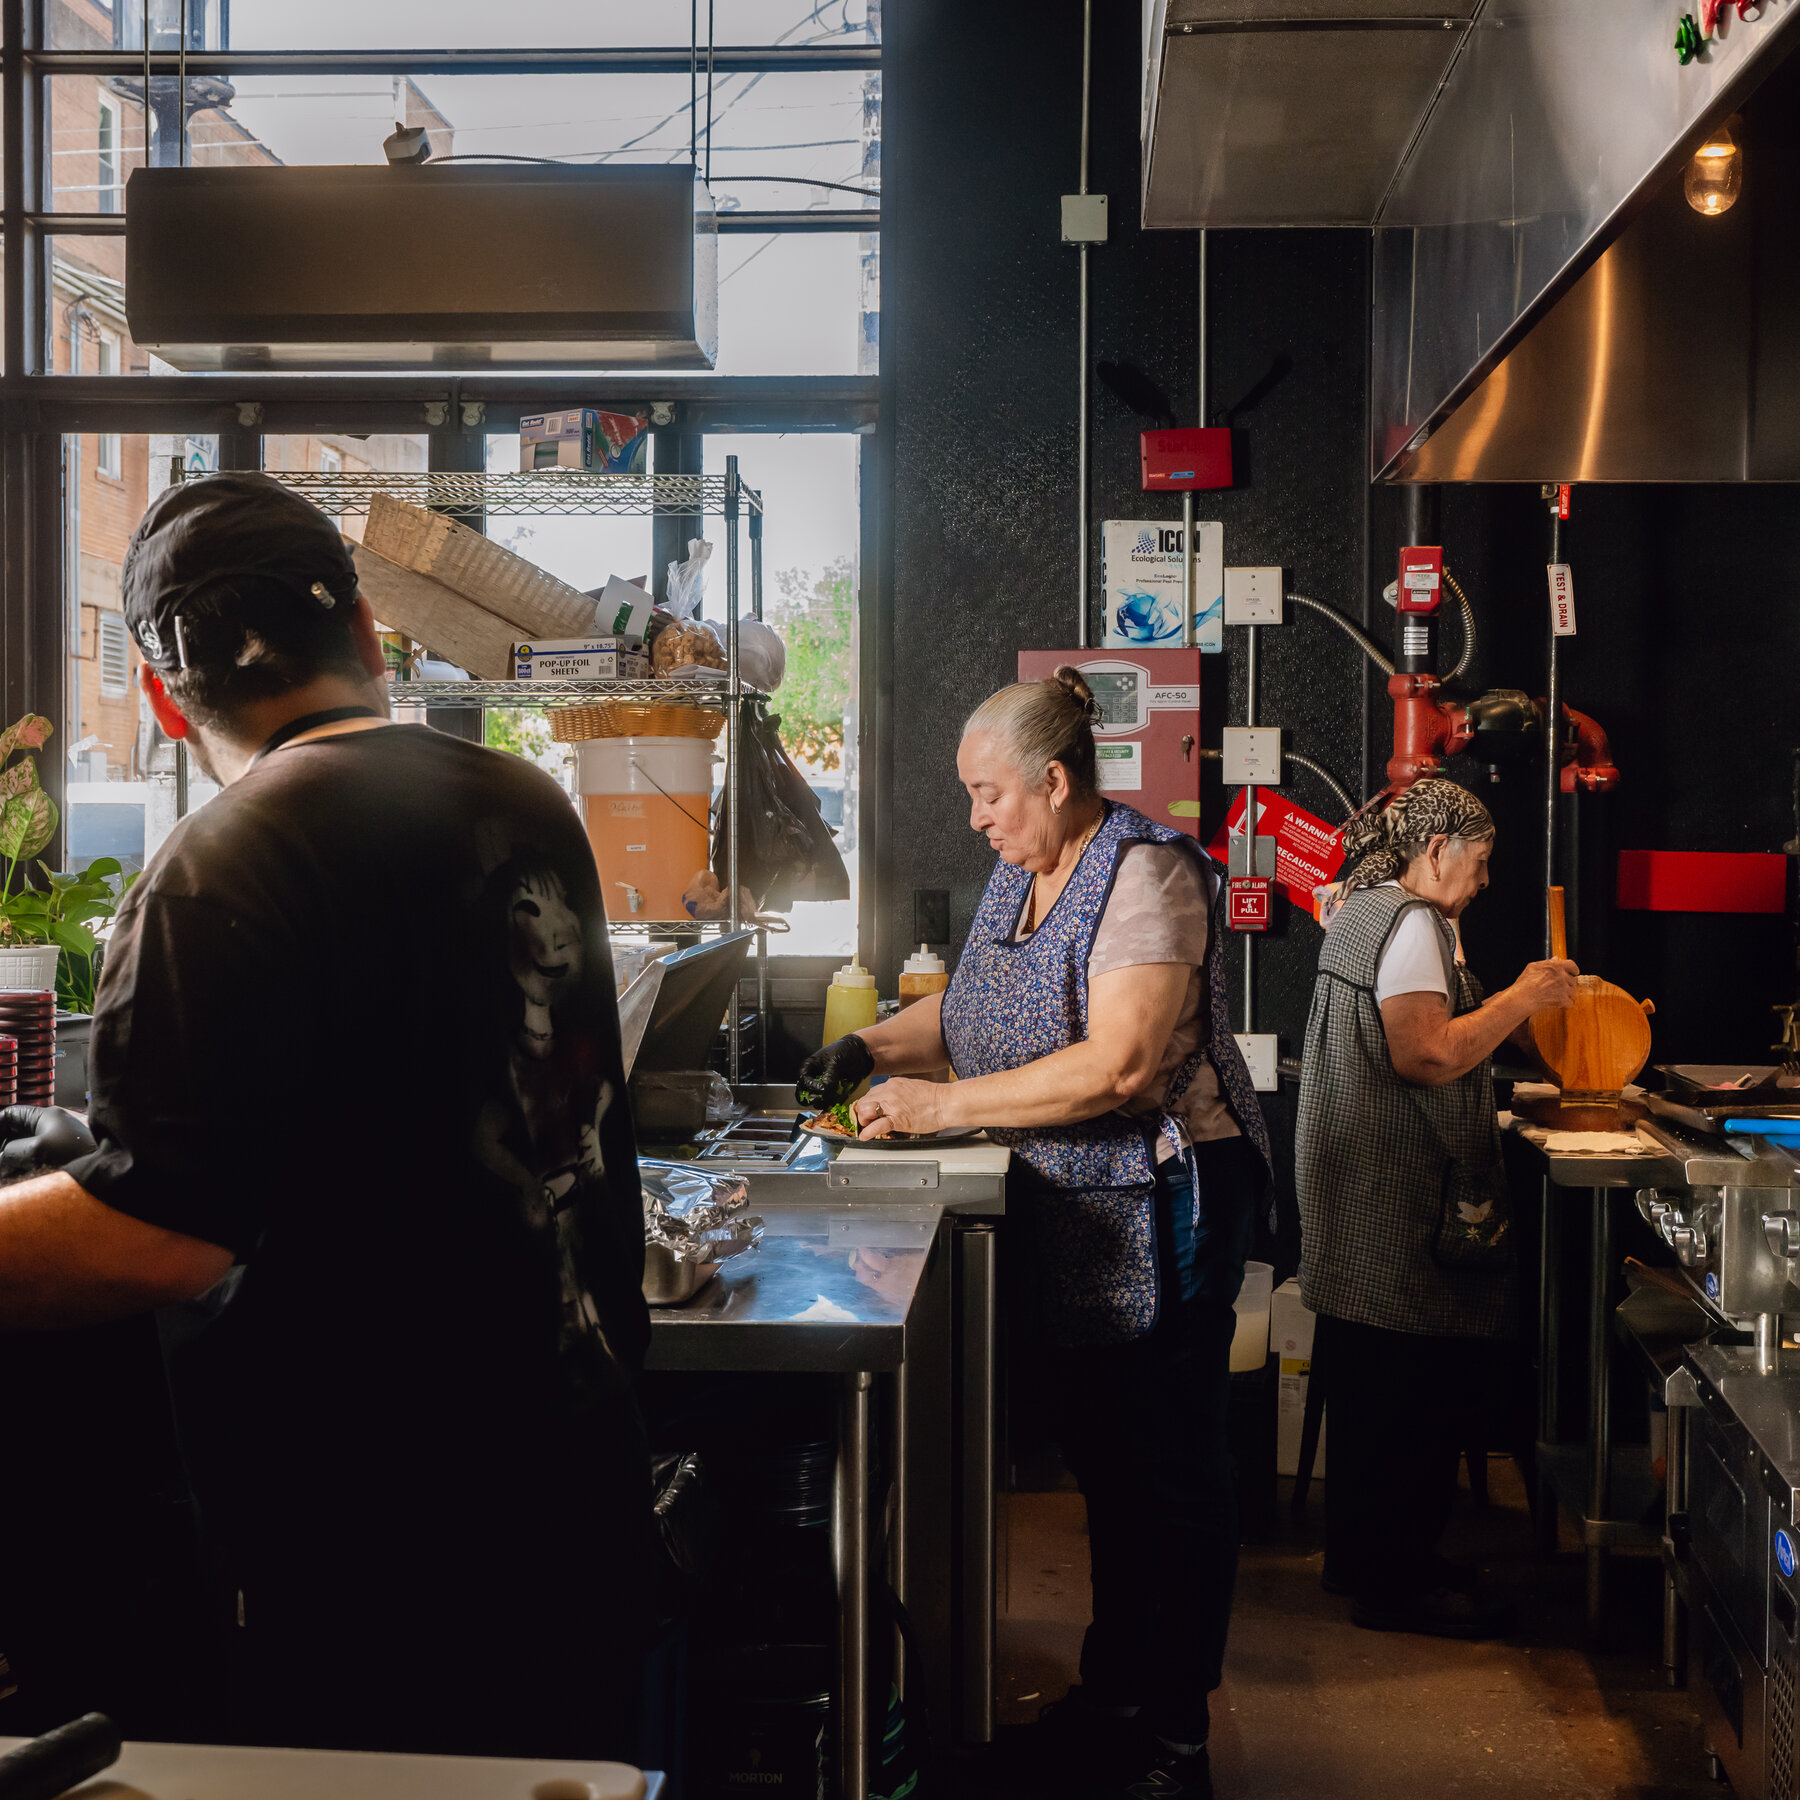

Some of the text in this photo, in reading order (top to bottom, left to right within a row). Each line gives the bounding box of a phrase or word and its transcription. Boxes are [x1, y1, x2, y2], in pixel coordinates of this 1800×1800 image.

[1159, 530, 1201, 553] ICON
[1131, 555, 1201, 563] Ecological Soluns
[1555, 572, 1566, 592] TEST
[1558, 603, 1568, 628] DRAIN
[539, 659, 590, 668] POP-UP FOIL
[551, 667, 579, 676] SHEETS
[1295, 817, 1337, 846] WARNING
[1276, 846, 1328, 880] RECAUCION
[729, 1772, 783, 1784] MORTON
